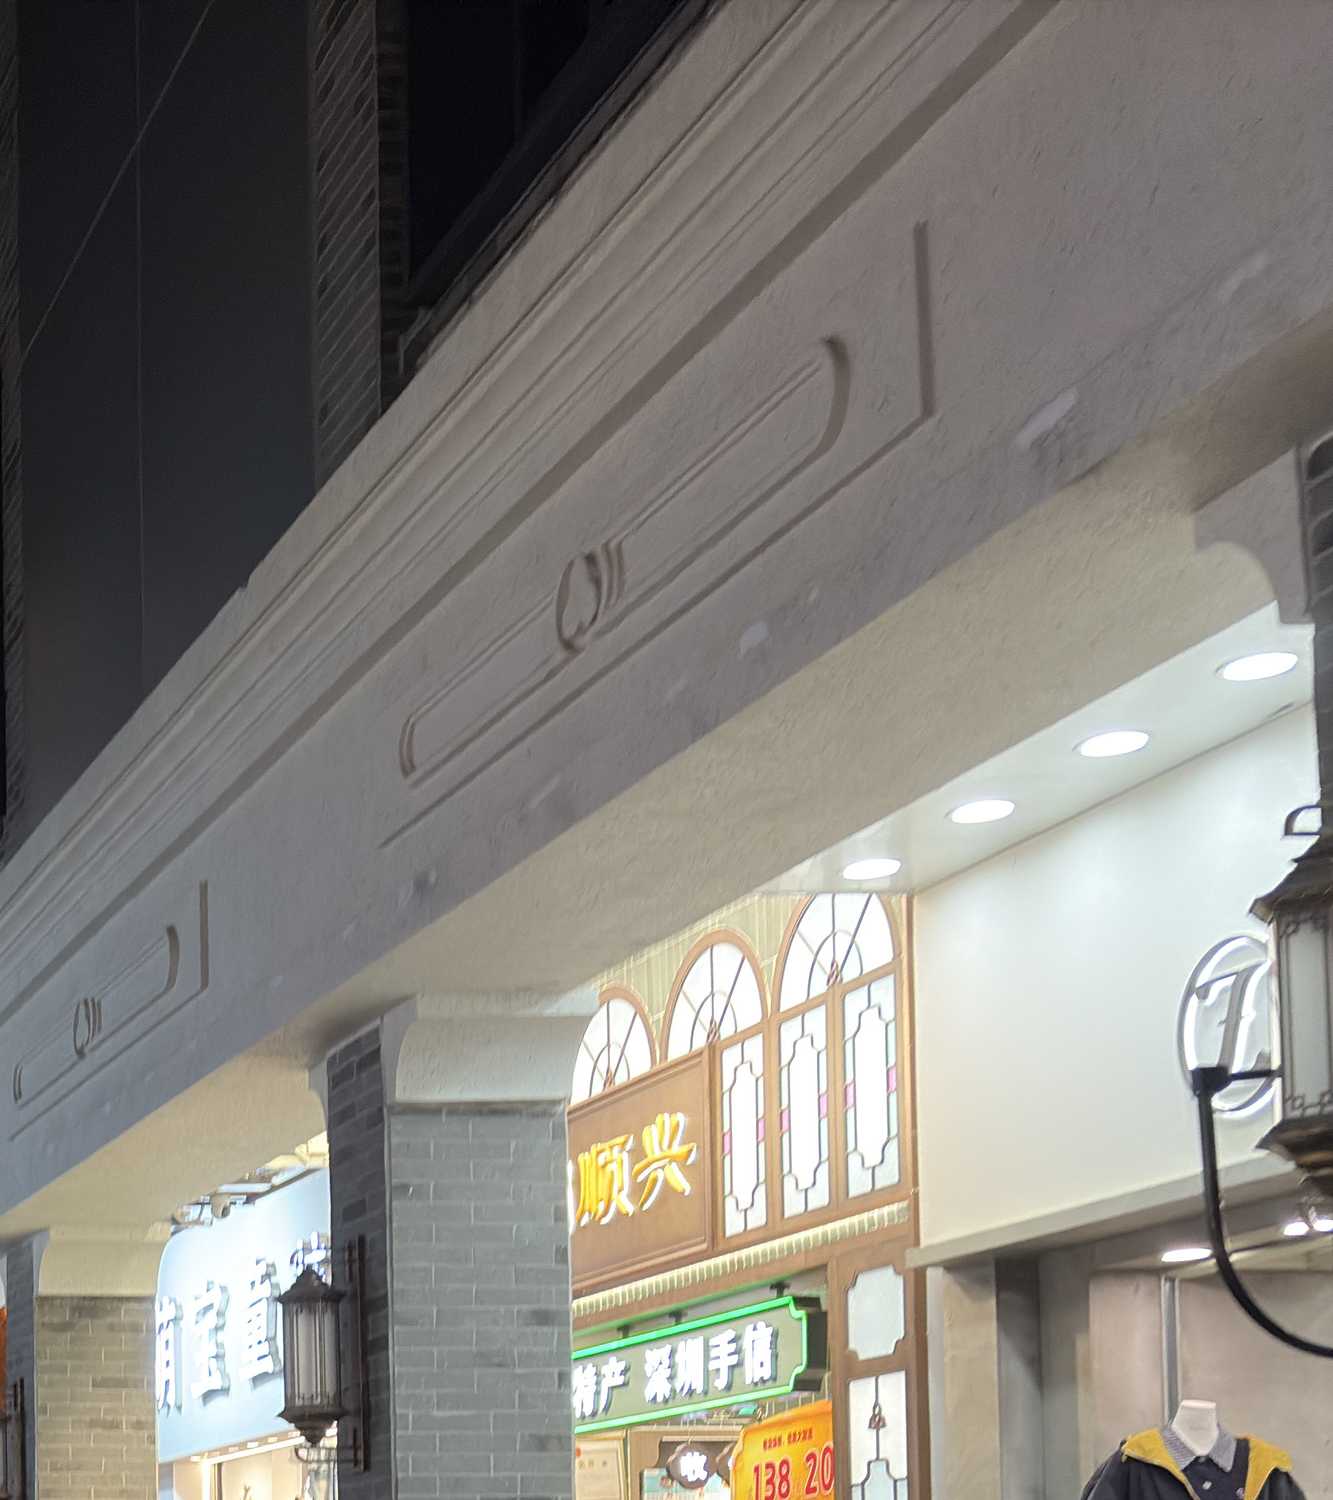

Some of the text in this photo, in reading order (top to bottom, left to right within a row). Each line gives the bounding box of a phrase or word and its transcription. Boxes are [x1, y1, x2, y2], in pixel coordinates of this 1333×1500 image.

[575, 1111, 697, 1227] 顺兴
[573, 1320, 776, 1421] 特产 深圳手信
